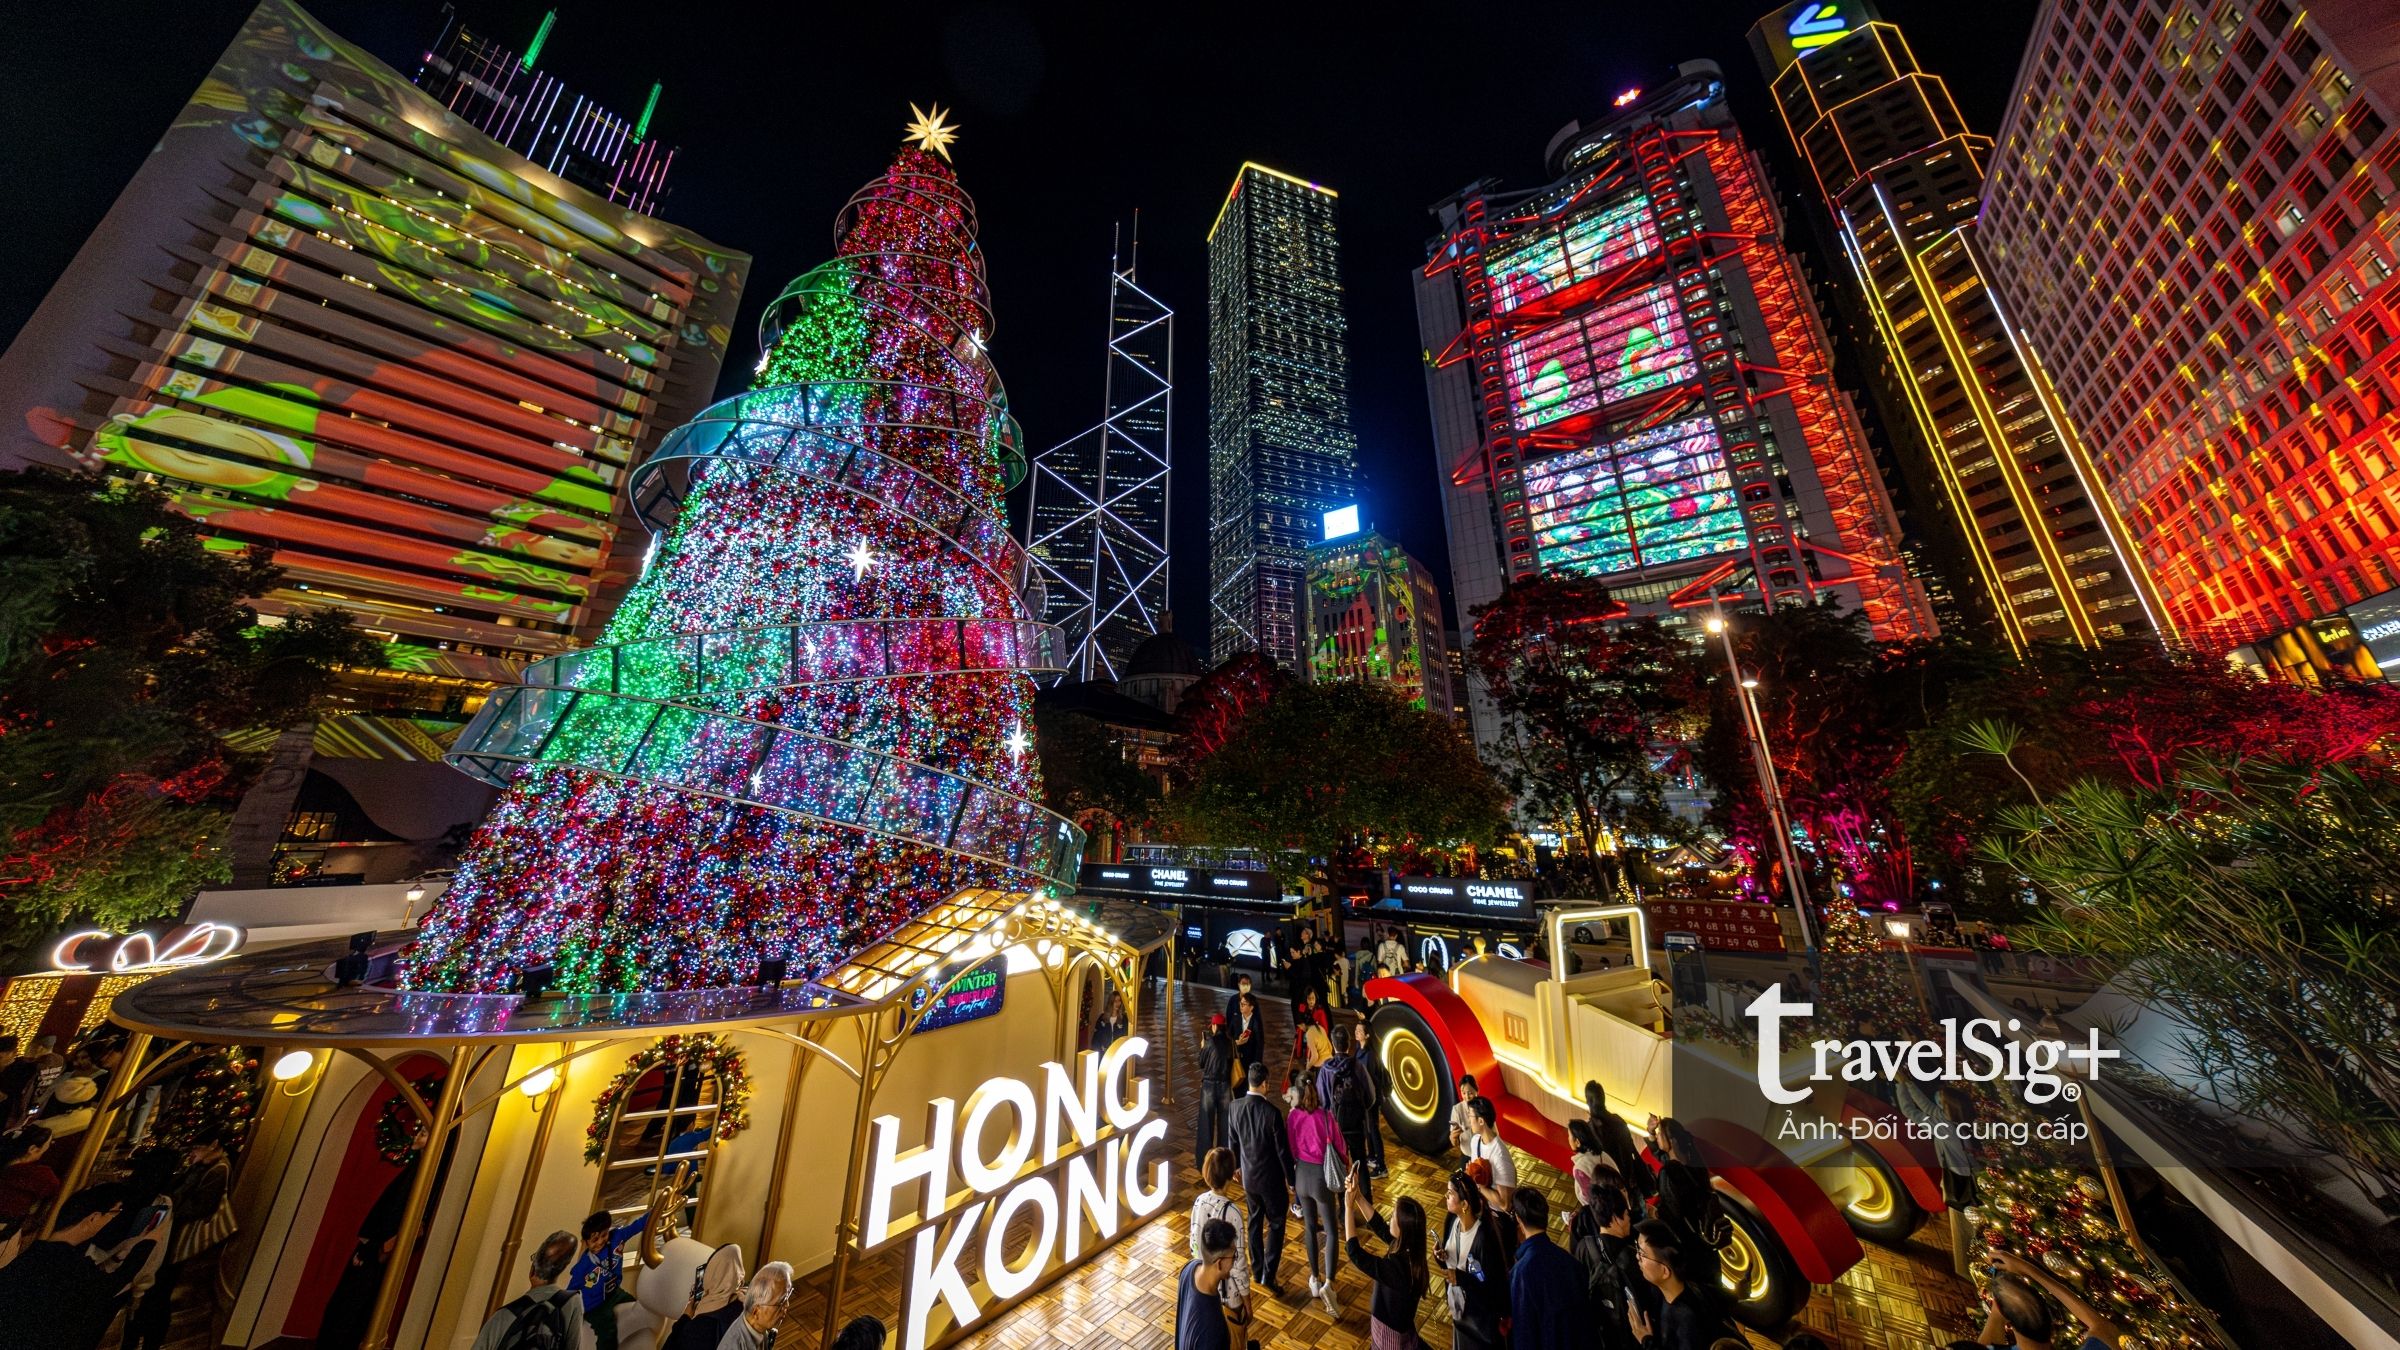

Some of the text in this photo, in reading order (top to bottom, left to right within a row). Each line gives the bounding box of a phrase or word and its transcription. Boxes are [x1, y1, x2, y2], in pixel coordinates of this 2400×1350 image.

[1151, 868, 1188, 881] CHANEL
[1214, 878, 1229, 886] COCO
[1408, 885, 1454, 895] COCO CRUSH
[1466, 885, 1524, 900] CHANEL
[1487, 899, 1519, 908] JEWELLERY
[951, 972, 997, 993] WINTER
[955, 997, 988, 1014] Central
[863, 1036, 1150, 1250] HONG
[904, 1118, 1169, 1350] KONG
